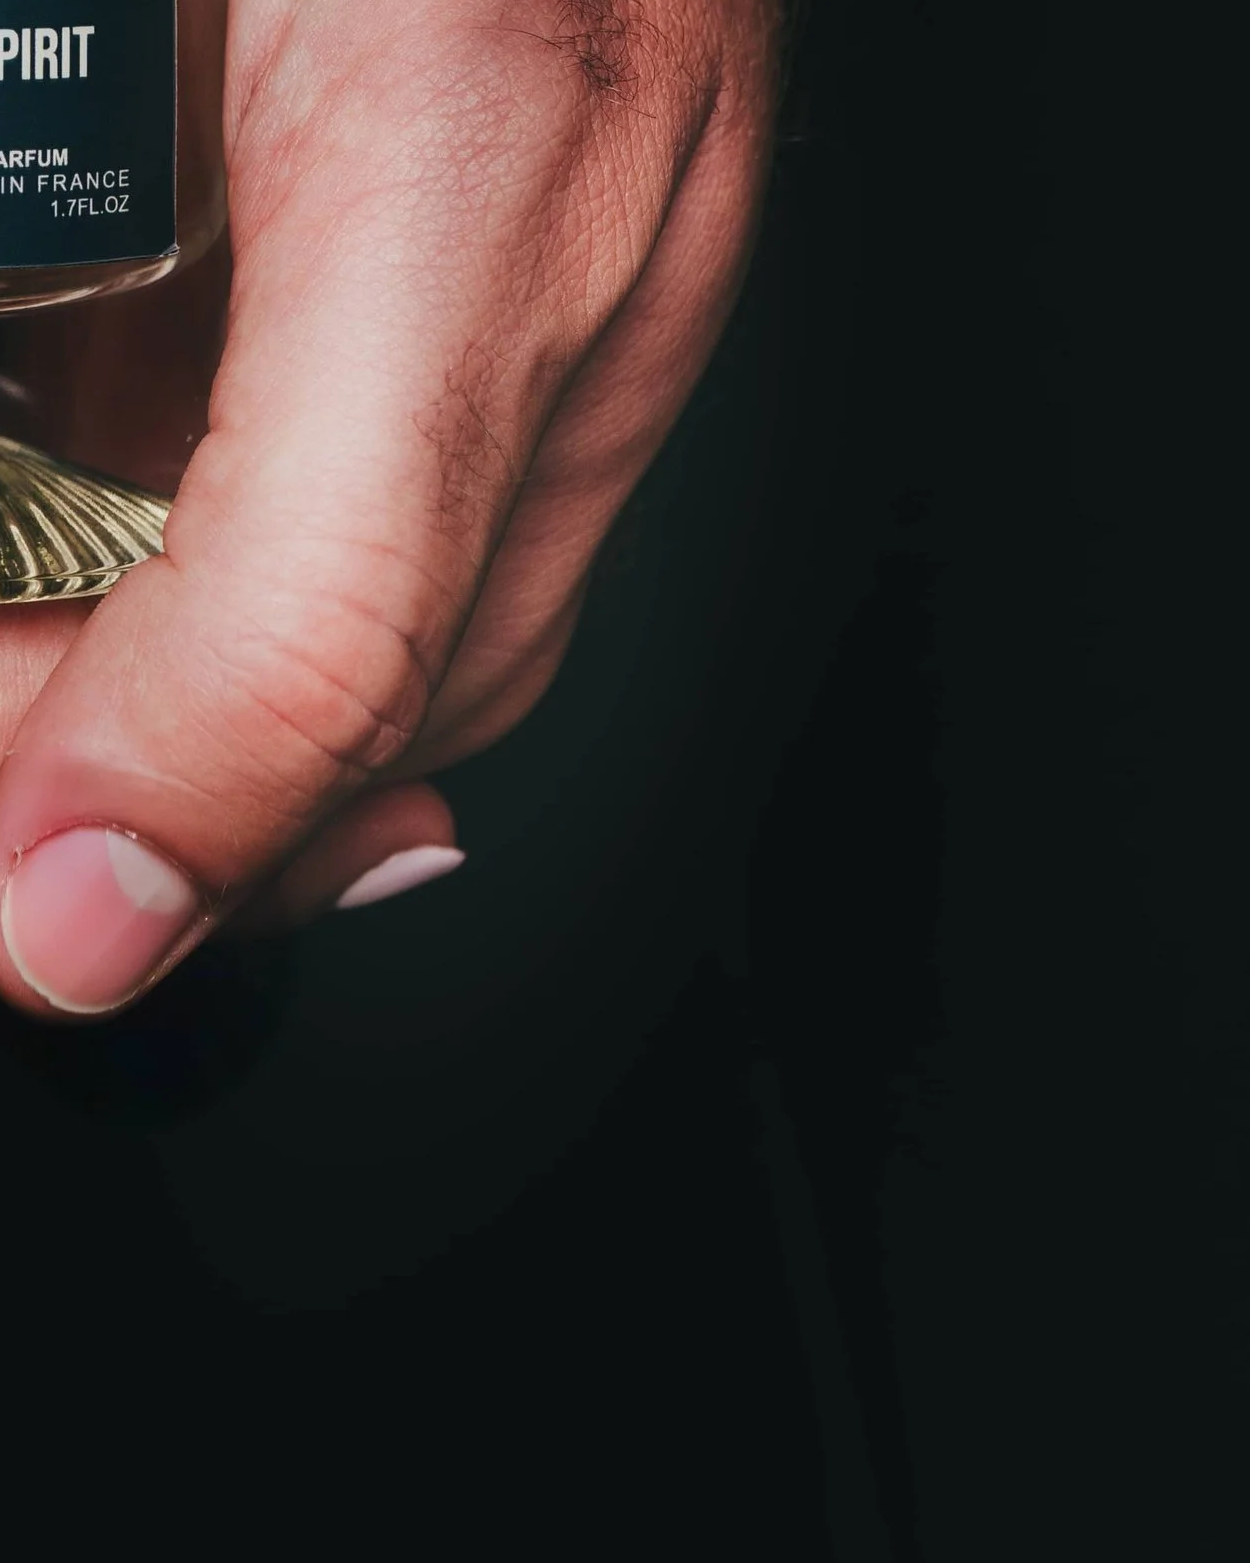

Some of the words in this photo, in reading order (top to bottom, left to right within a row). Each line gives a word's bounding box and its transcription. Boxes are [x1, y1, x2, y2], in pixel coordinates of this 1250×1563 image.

[0, 175, 24, 194] IN
[37, 169, 130, 193] FRANCE
[50, 194, 130, 218] 1.7FL.OZ
